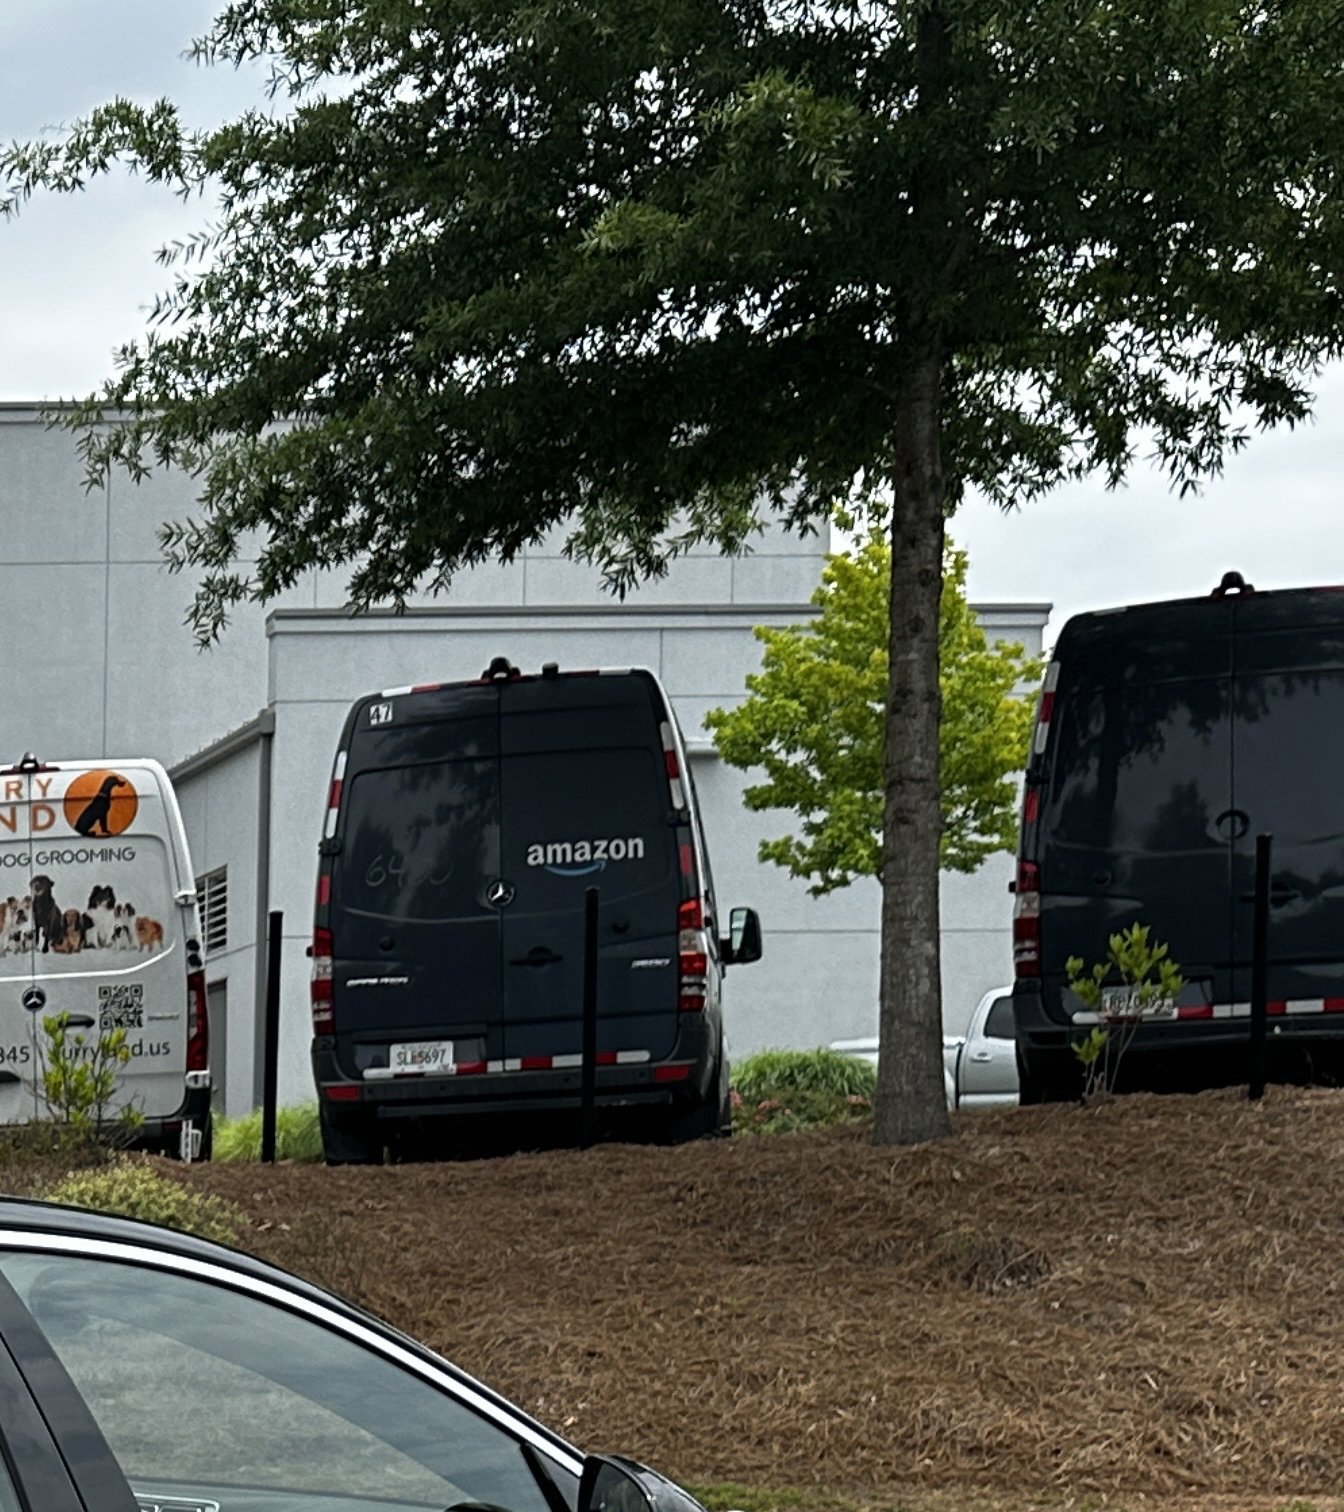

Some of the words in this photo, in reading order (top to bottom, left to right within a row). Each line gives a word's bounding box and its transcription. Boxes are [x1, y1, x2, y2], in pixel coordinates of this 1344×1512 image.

[370, 703, 391, 722] 47
[35, 846, 136, 866] GROOMING
[526, 837, 645, 867] amazon
